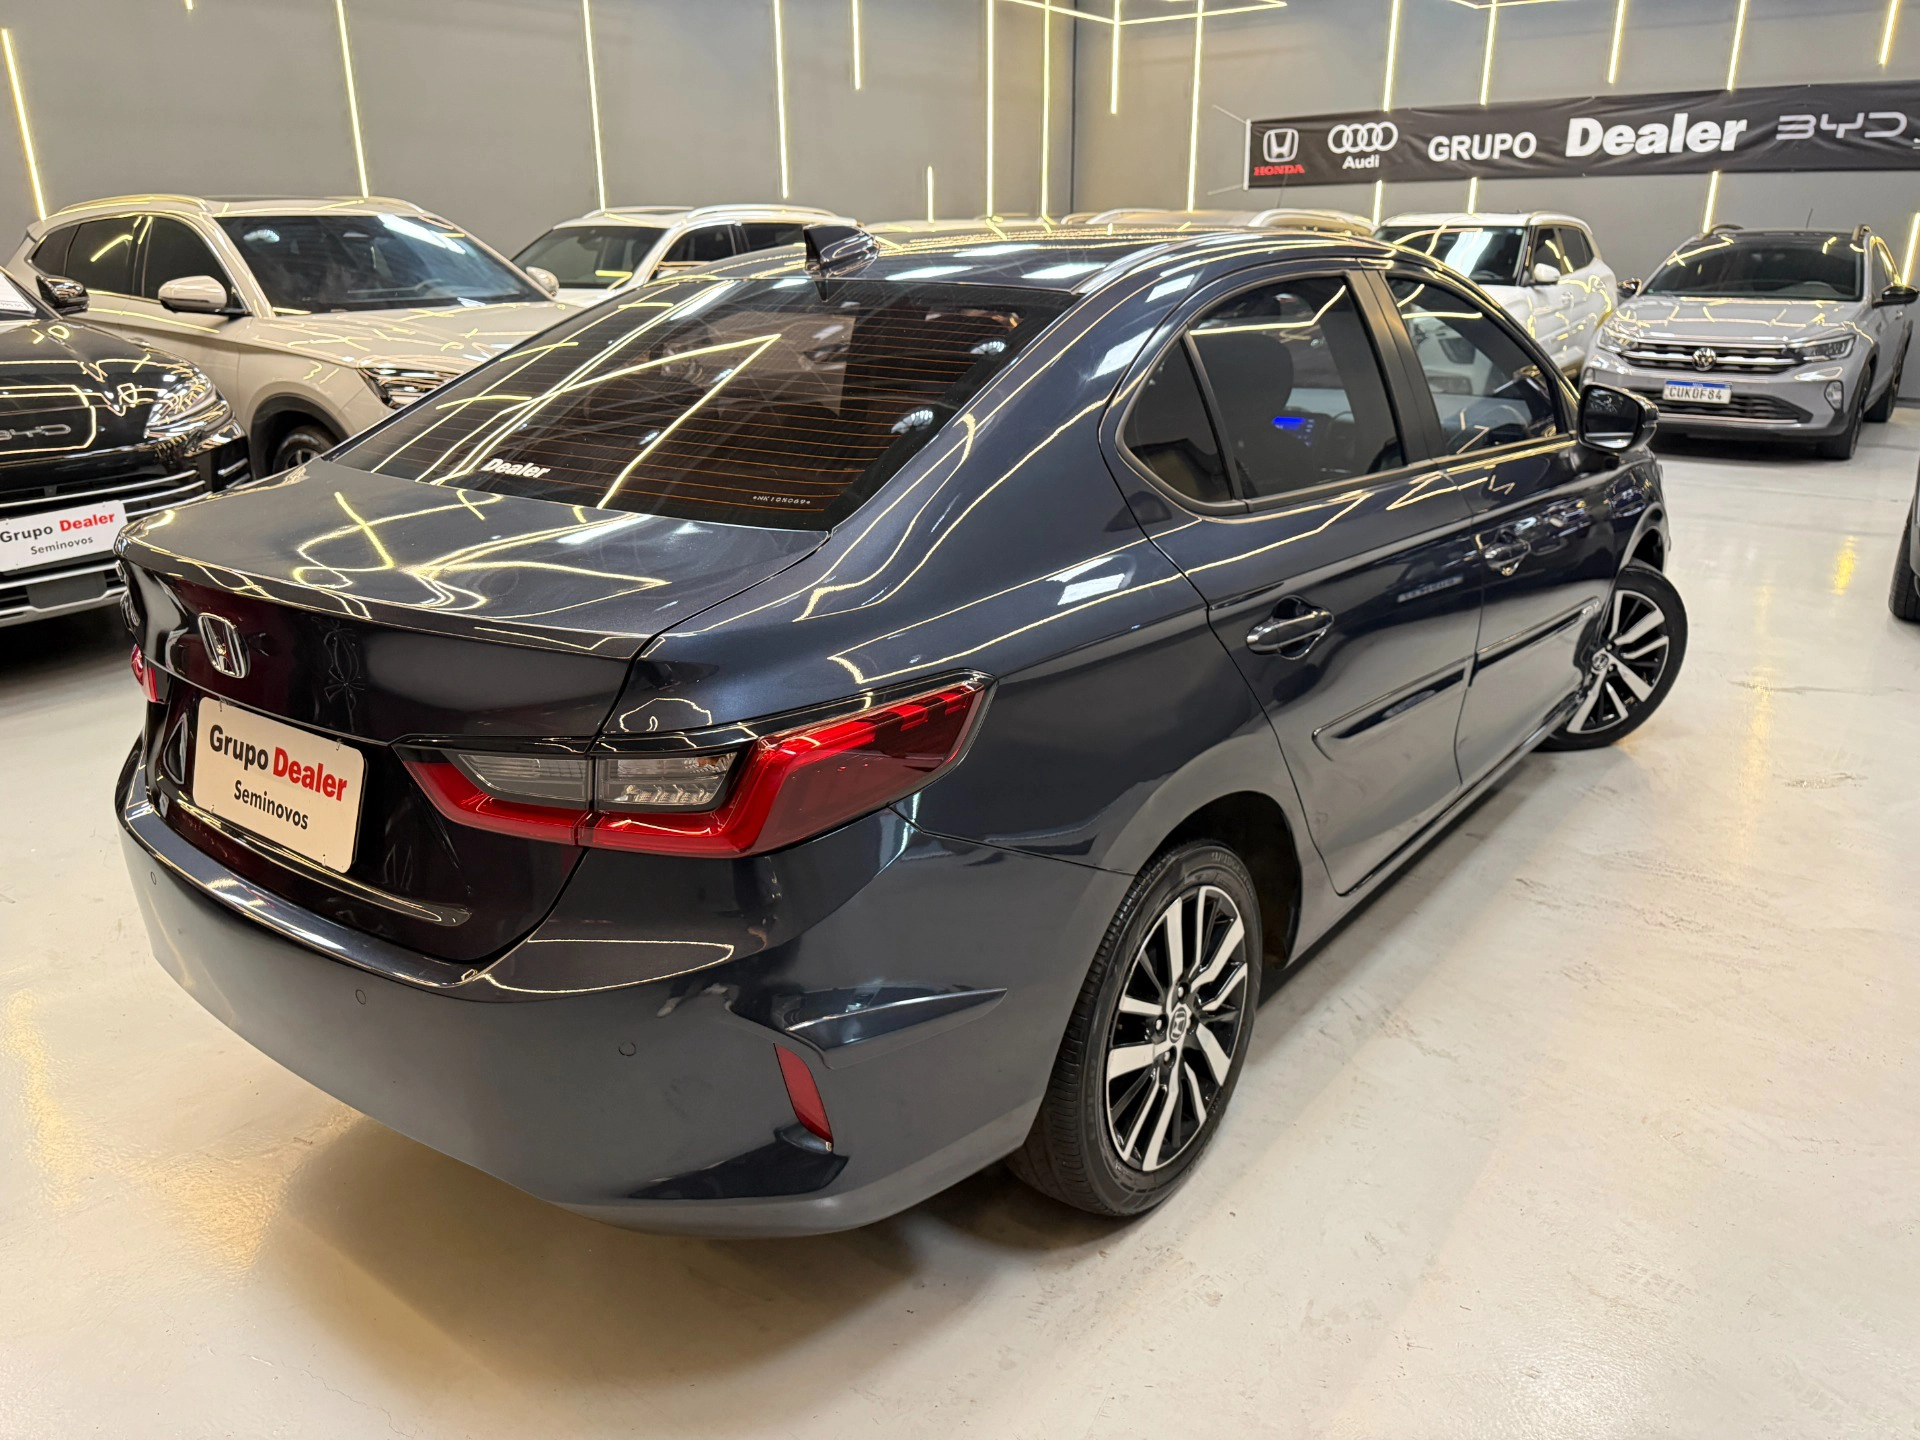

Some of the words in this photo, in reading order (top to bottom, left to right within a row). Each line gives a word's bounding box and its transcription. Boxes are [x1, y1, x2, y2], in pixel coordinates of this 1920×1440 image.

[1428, 131, 1537, 162] GRUPO
[1565, 112, 1747, 157] Dealer
[1776, 111, 1908, 141] BYD
[1254, 164, 1305, 176] HONDA
[1342, 154, 1380, 169] Audi
[480, 458, 551, 478] Dealer
[0, 526, 53, 543] Grupo
[59, 513, 115, 532] Dealer
[30, 536, 94, 555] Seminovos
[209, 724, 269, 771] Grupo
[272, 746, 348, 802] Dealer
[233, 779, 309, 830] Seminovos
